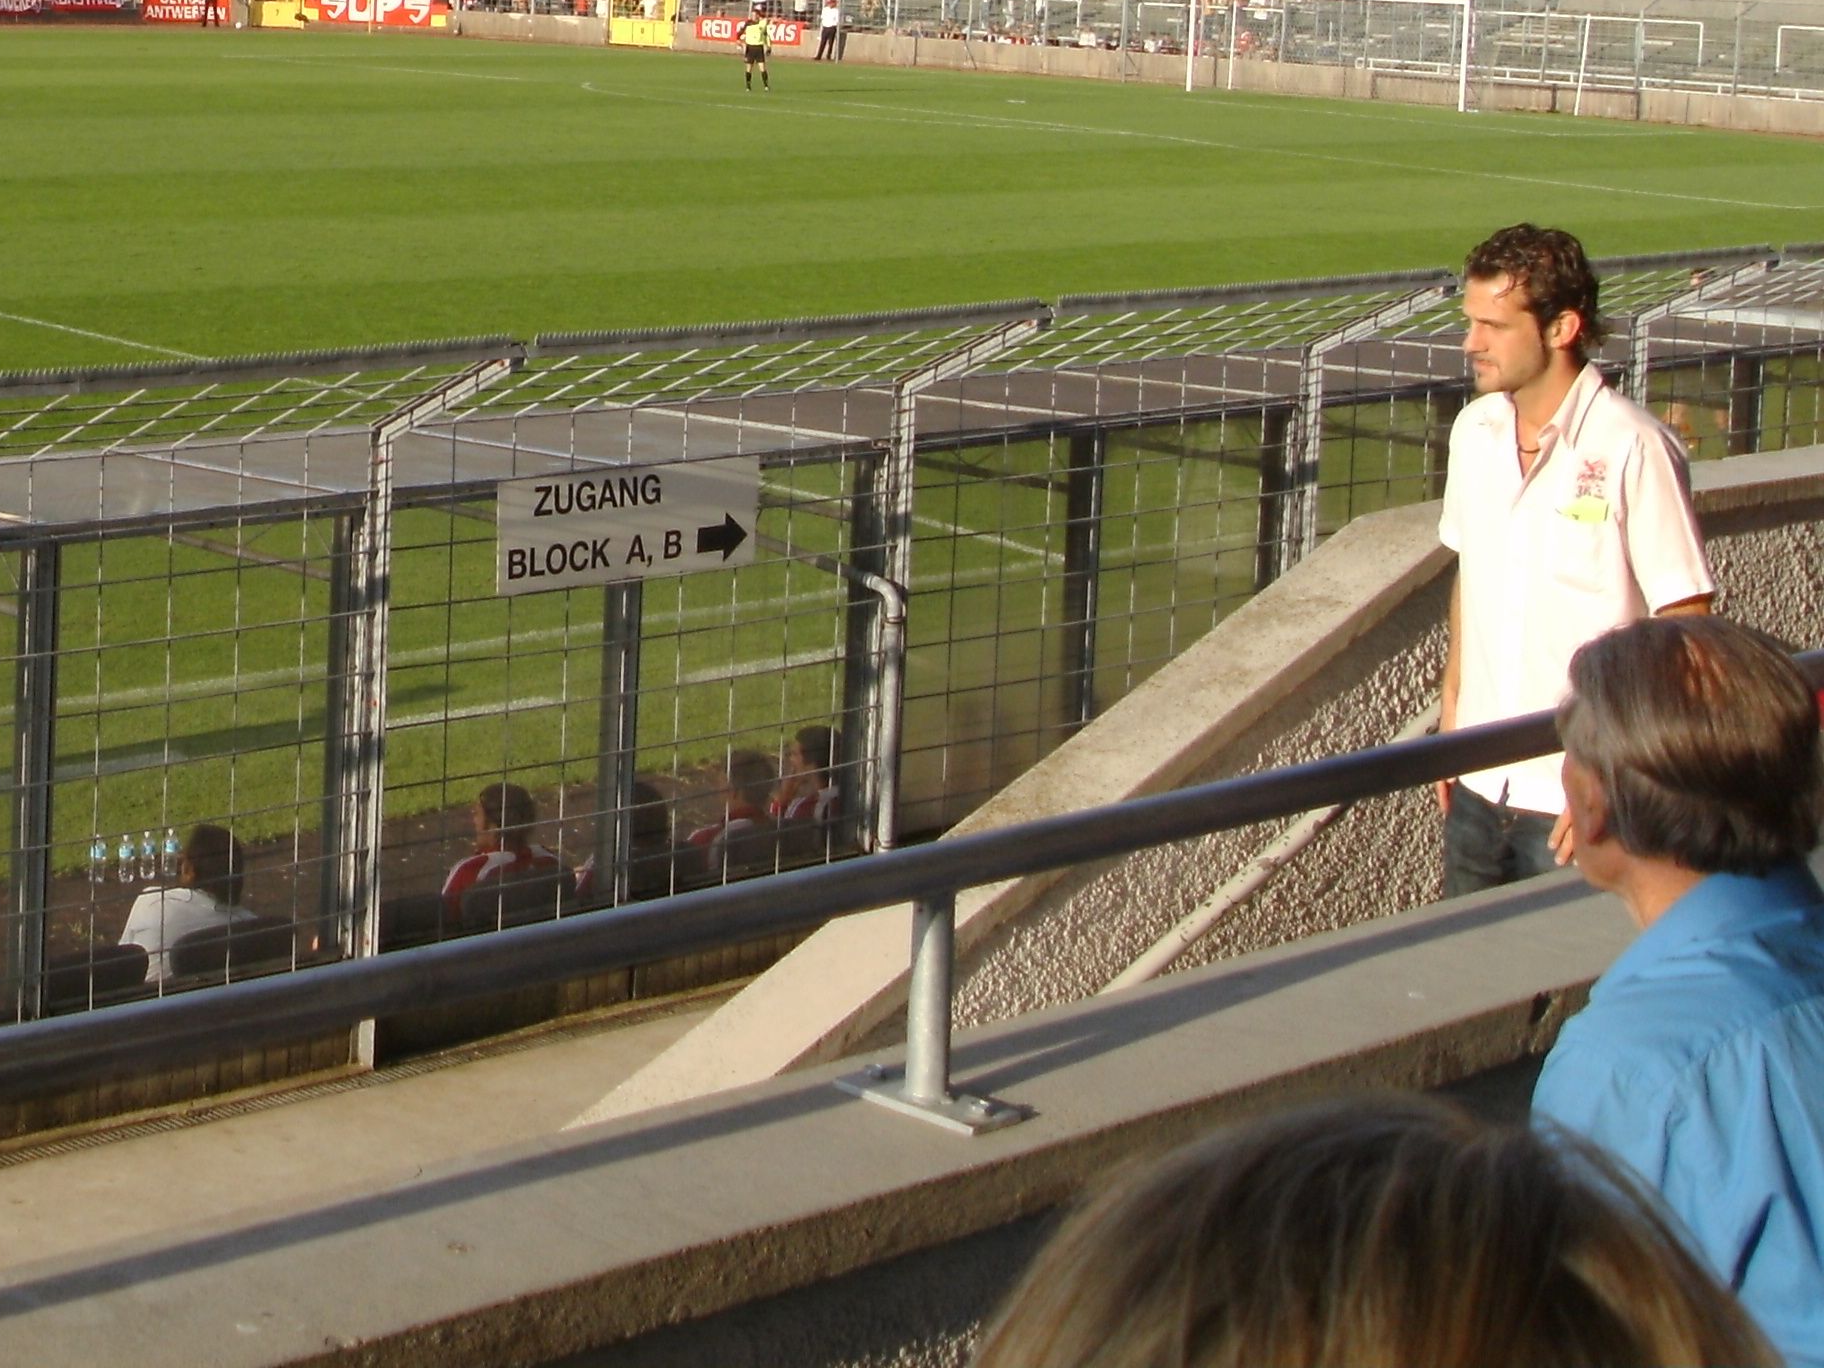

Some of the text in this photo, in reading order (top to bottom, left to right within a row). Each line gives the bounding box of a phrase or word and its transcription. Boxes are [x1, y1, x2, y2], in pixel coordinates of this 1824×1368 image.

[701, 19, 732, 39] RED
[533, 474, 662, 517] ZUGANG
[507, 530, 682, 580] BLOCK A, B
